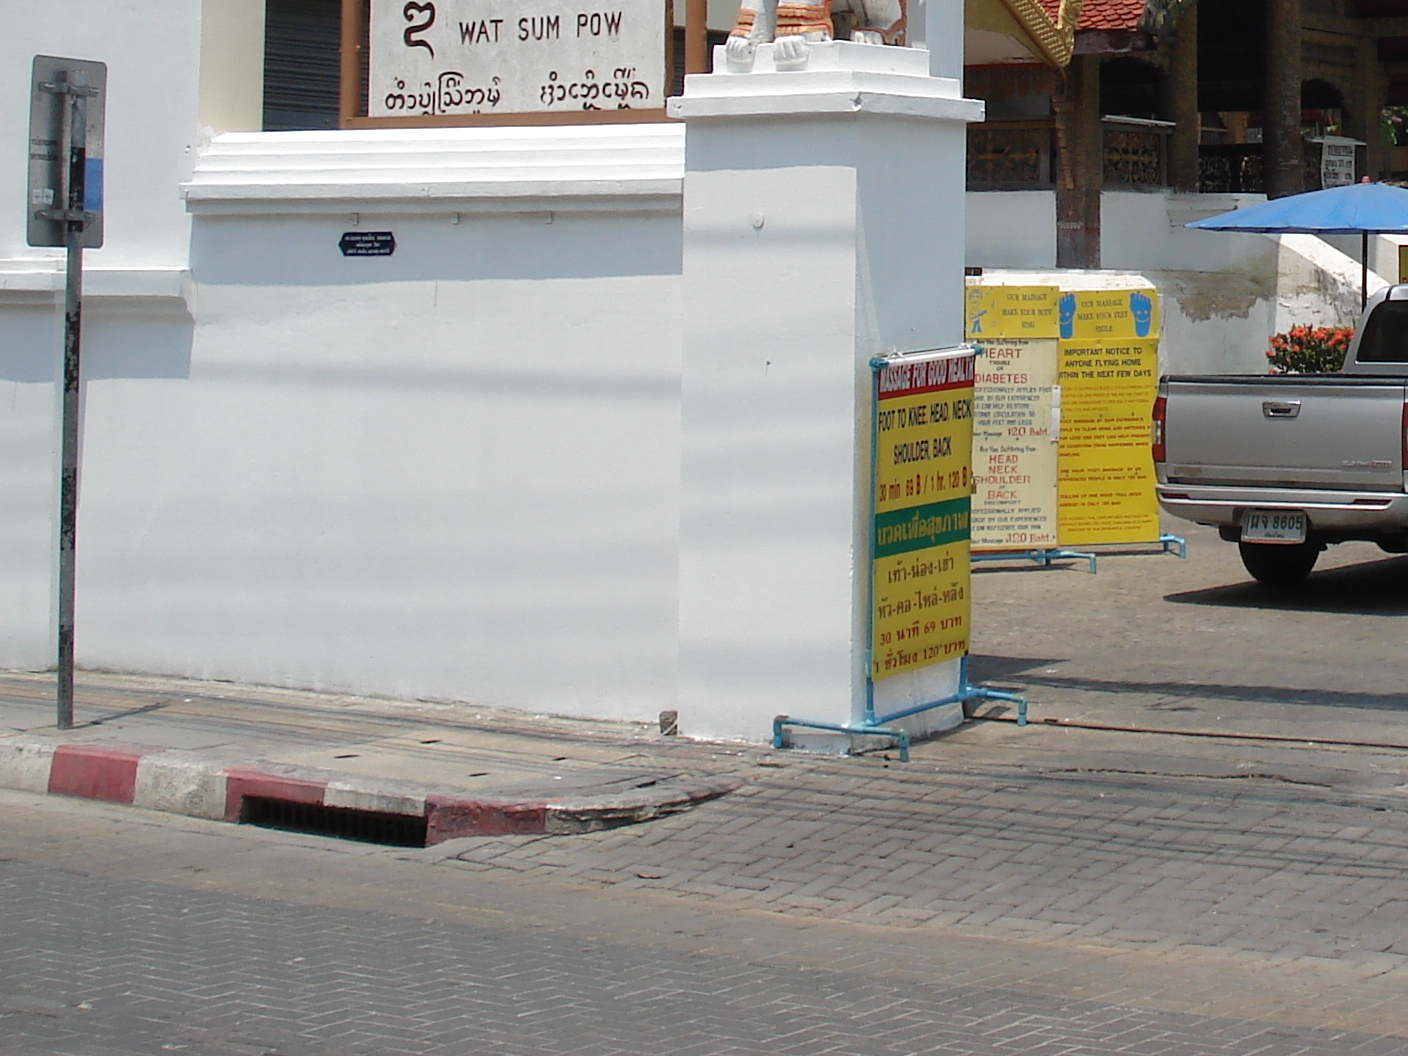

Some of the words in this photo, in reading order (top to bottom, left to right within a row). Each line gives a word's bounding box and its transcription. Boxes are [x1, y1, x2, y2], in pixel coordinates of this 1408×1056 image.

[459, 19, 504, 45] WAT
[518, 15, 561, 41] SUM
[577, 11, 623, 38] POW
[1064, 348, 1103, 356] IMPORTANT
[1105, 347, 1130, 355] NOTICE
[1095, 359, 1119, 367] FLYING
[1121, 358, 1141, 366] HOME
[880, 364, 911, 393] MASSAGE
[913, 362, 927, 388] FOR
[928, 359, 947, 386] GOOD
[948, 356, 974, 383] HEALTH
[975, 373, 1028, 384] DIABETES
[1097, 370, 1114, 378] NEXT
[1133, 369, 1151, 377] DAYS
[879, 409, 895, 432] FOOT
[897, 408, 906, 428] TO
[952, 399, 972, 420] NECK
[1008, 427, 1026, 436] 120
[933, 436, 951, 458] BACK
[989, 454, 1018, 464] HEAD
[988, 465, 1018, 474] NECK
[974, 475, 1031, 484] SHOULDER
[880, 484, 886, 502] 30
[889, 478, 900, 500] min
[906, 478, 913, 496] 69
[948, 470, 959, 489] 120
[987, 490, 1017, 500] BACK
[1272, 515, 1303, 530] 8605
[1007, 533, 1027, 543] 120
[880, 632, 891, 646] 30
[897, 620, 919, 641] นาที
[924, 621, 936, 634] 69
[940, 616, 962, 630] บาท
[885, 649, 918, 670] ชั่วโมง
[923, 645, 939, 660] 120
[943, 640, 965, 655] บาท
